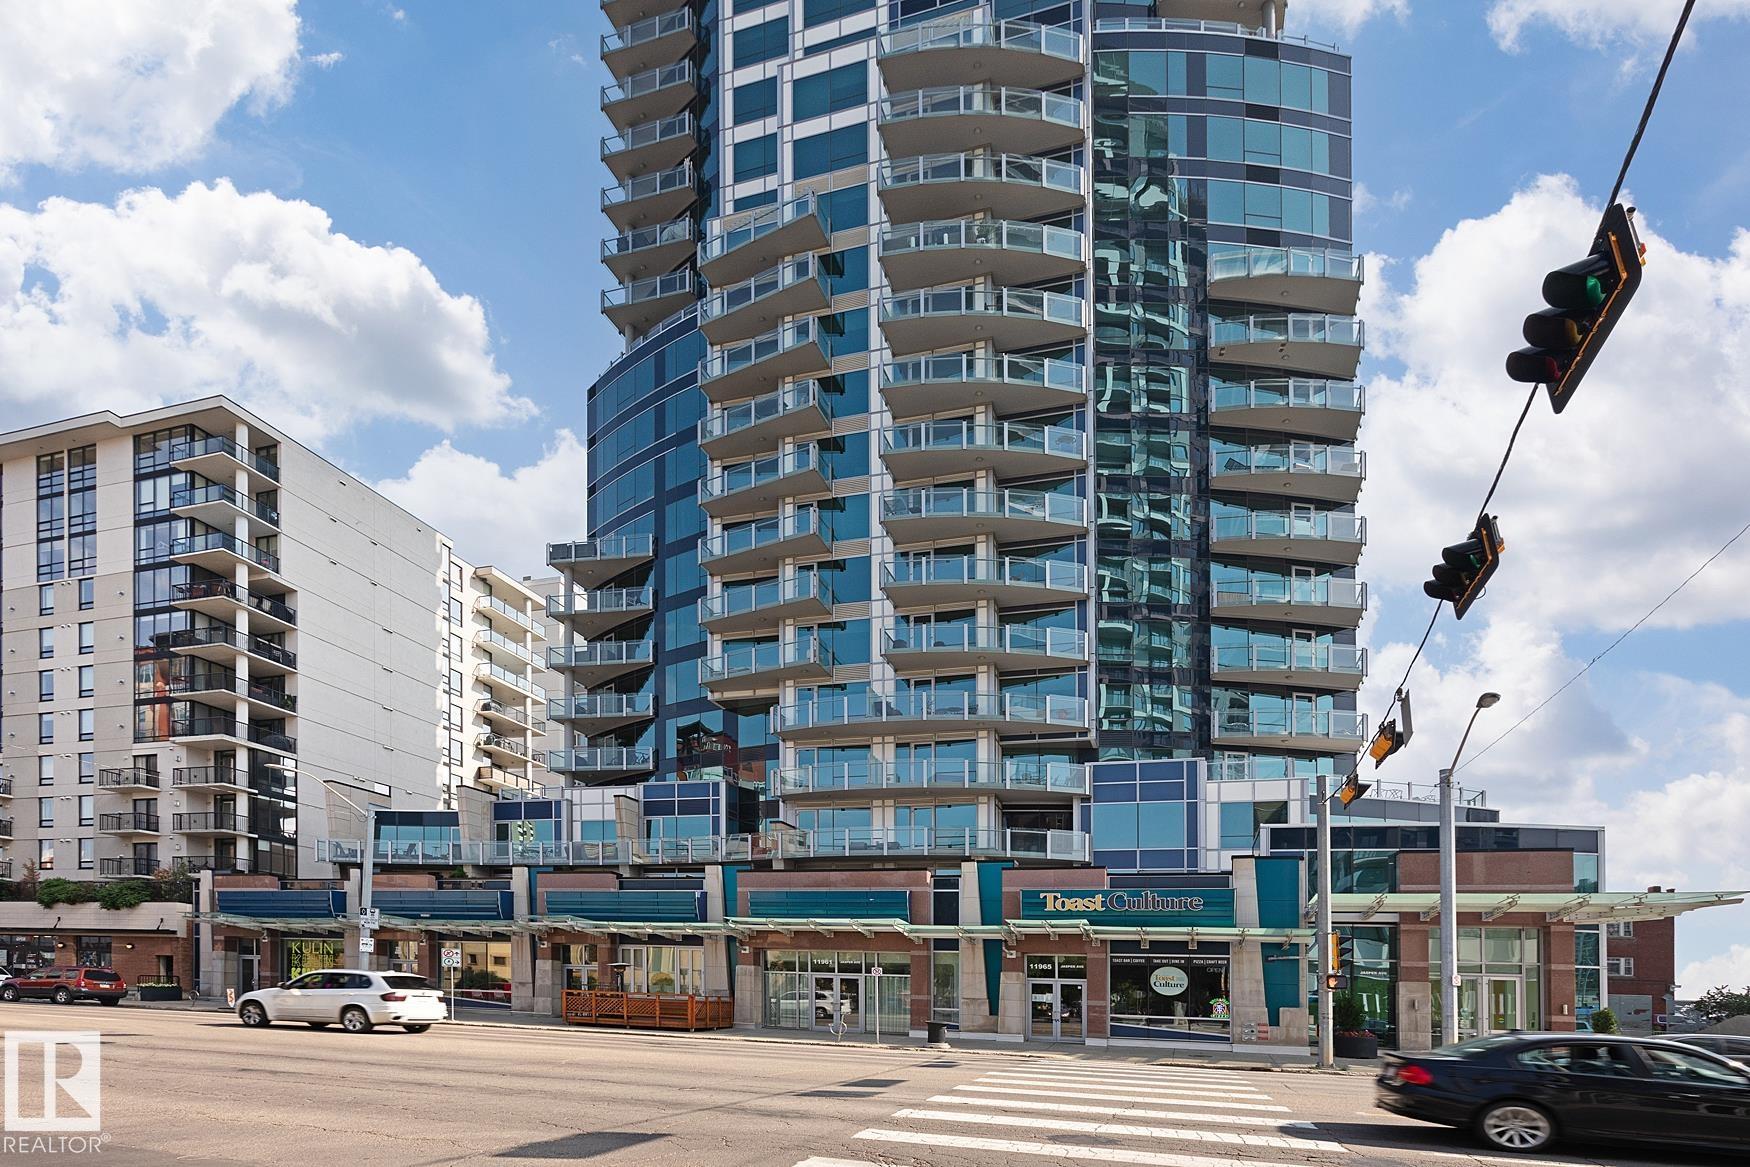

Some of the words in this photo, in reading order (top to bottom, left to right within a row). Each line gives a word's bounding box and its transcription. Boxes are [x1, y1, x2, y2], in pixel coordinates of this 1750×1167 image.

[1039, 892, 1106, 911] Toast
[1107, 891, 1204, 911] Culture
[291, 942, 334, 954] KULIN
[1153, 980, 1185, 989] Culture
